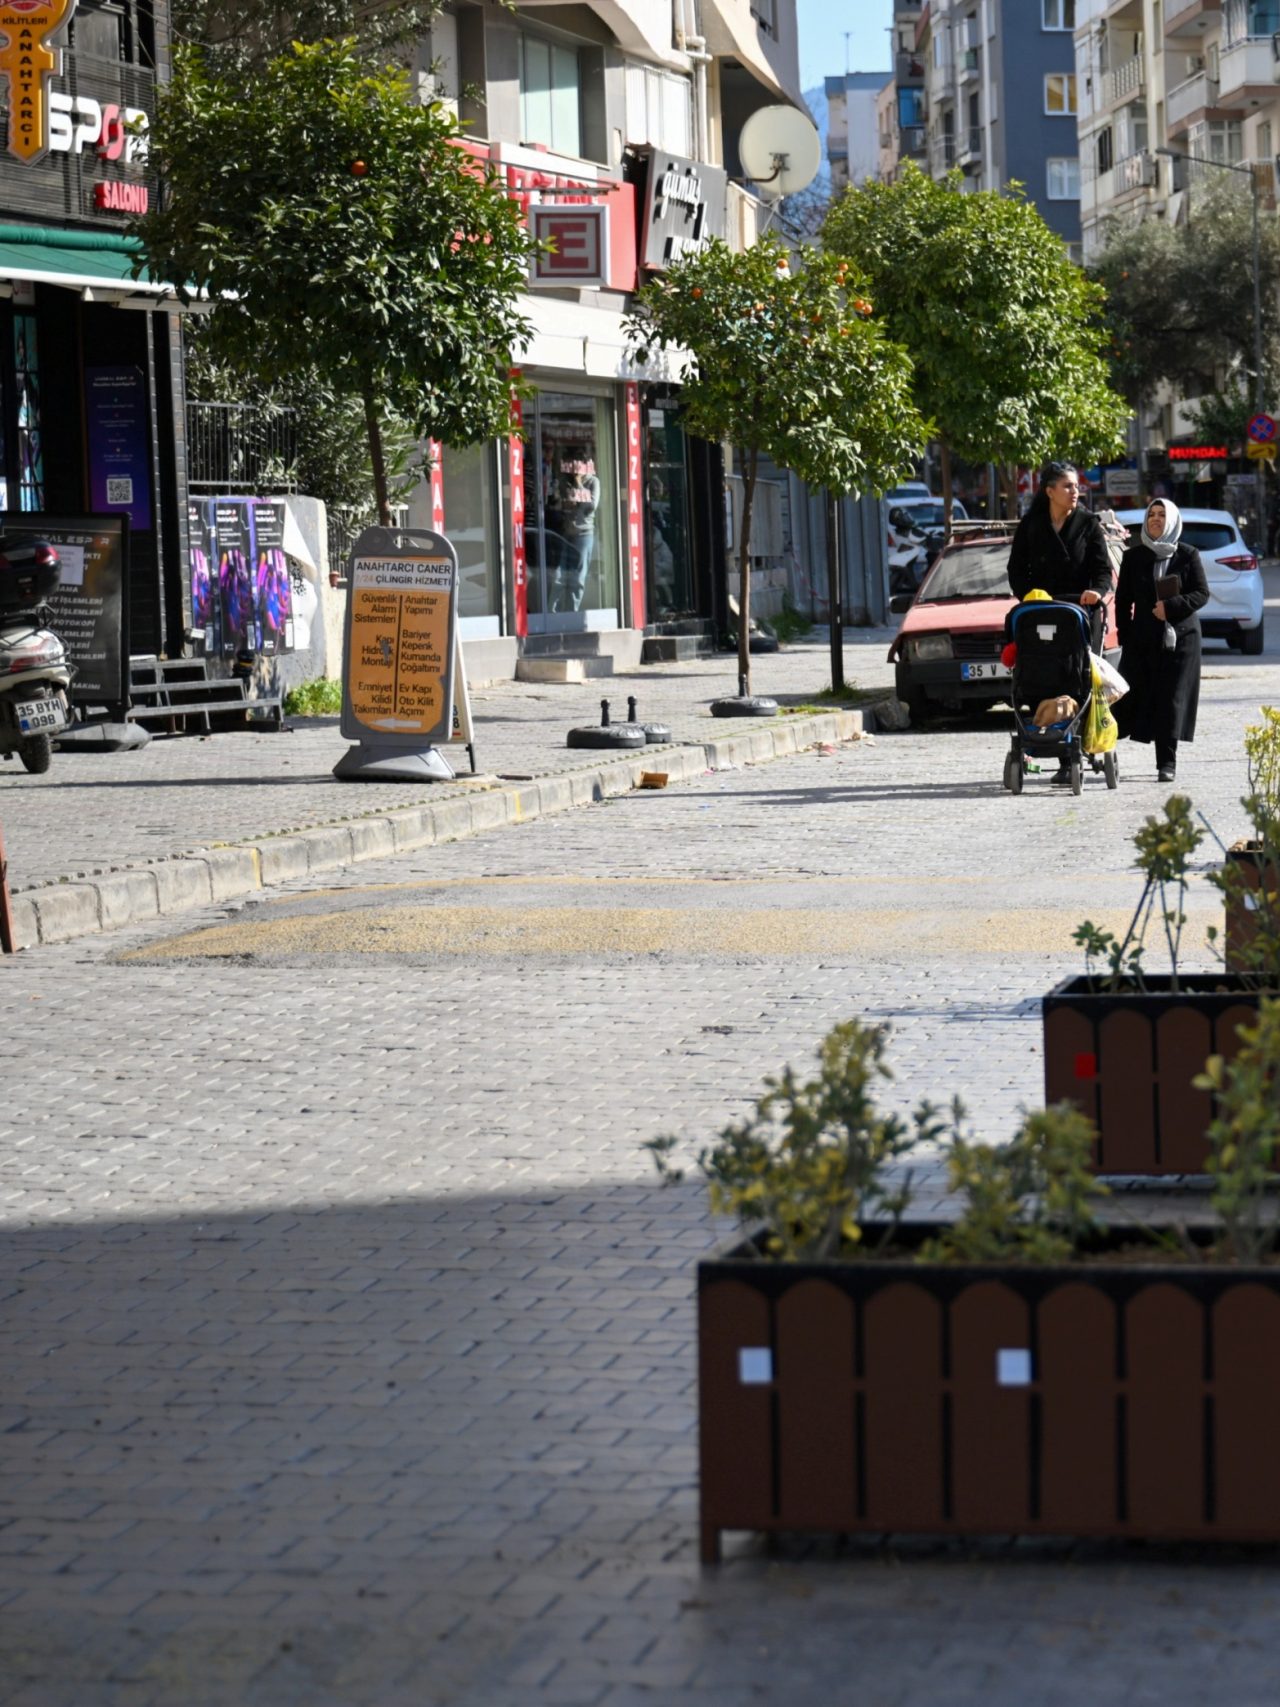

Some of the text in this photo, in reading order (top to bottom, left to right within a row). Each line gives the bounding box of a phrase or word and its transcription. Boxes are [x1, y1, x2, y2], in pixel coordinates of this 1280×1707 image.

[20, 29, 33, 146] ANAHTARCI
[50, 92, 149, 167] SPOR
[104, 180, 149, 215] SALONU
[356, 562, 451, 574] ANAHTARCI CANER
[375, 575, 413, 585] ÇİLİNGİR
[361, 593, 398, 603] Güvenlik
[405, 595, 438, 605] Anahtar
[371, 604, 397, 613] Alarm
[404, 605, 433, 616] Yapımı
[354, 614, 396, 623] Sistemleri
[402, 629, 432, 640] Bariyer
[401, 641, 433, 651] Kepenk
[401, 652, 441, 662] Kumanda
[400, 662, 441, 674] Çoğaltımı
[969, 664, 997, 677] 35 V
[358, 681, 393, 693] Emniyet
[399, 684, 432, 694] Ev Kapı
[371, 695, 393, 704] Kilidi
[399, 696, 434, 706] Oto Kilit
[18, 700, 60, 717] 35 BYH
[353, 705, 392, 715] Takımları
[399, 706, 425, 717] Açımı
[32, 714, 56, 727] 098
